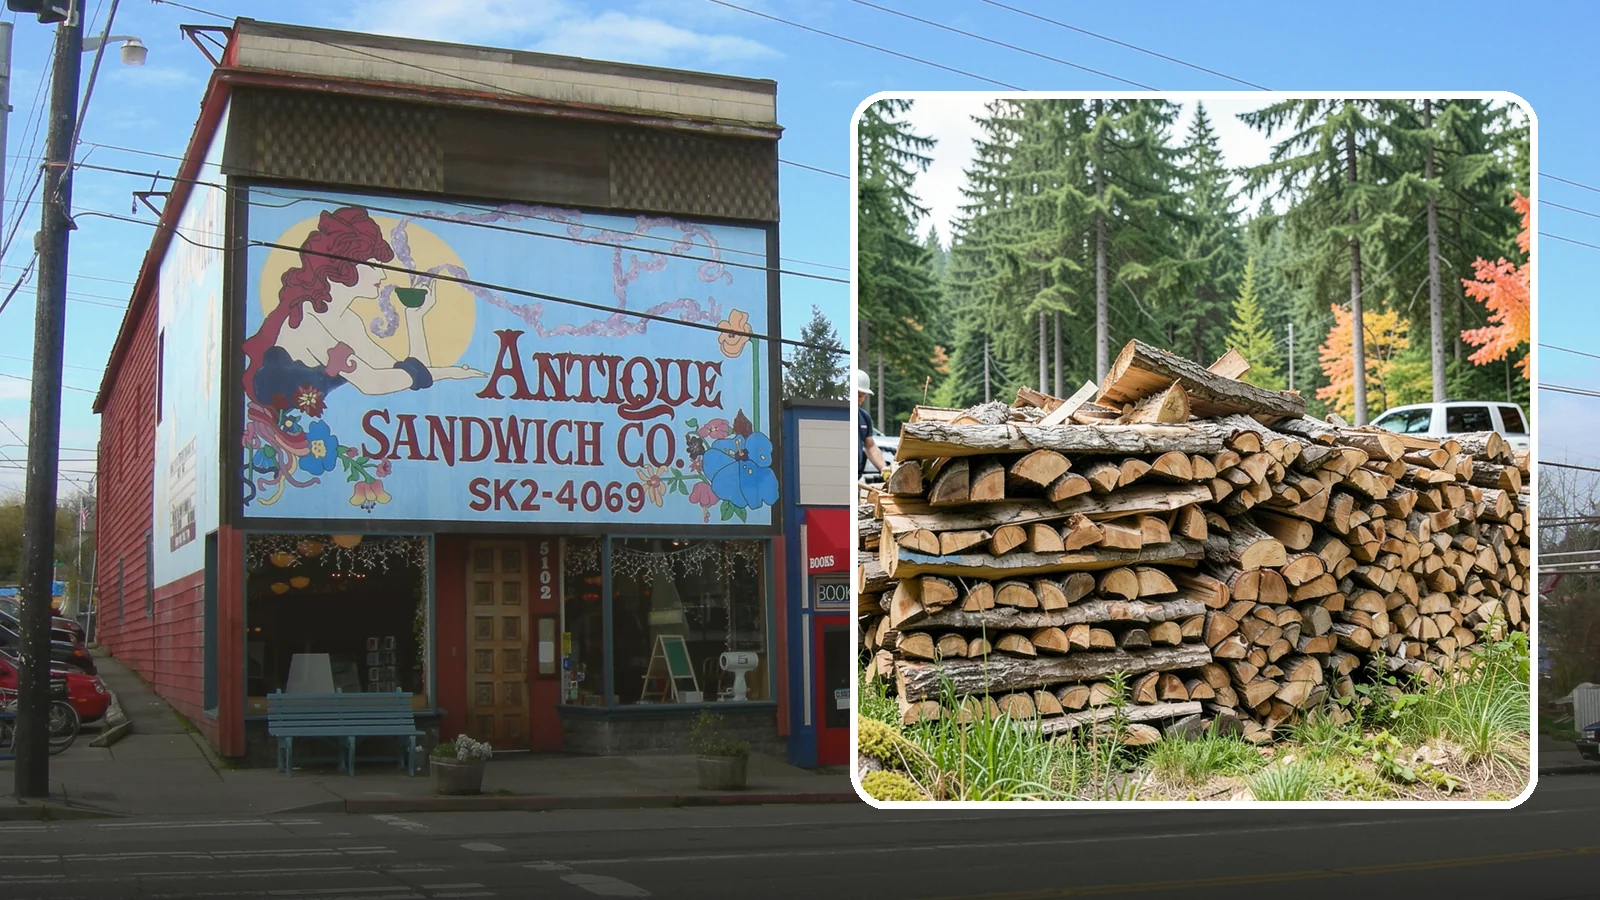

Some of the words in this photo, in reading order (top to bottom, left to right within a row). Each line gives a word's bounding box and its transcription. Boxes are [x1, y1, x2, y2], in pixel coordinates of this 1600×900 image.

[476, 329, 724, 420] ANTIQUE
[361, 408, 605, 467] SANDWICH
[617, 421, 685, 468] CO.
[468, 477, 646, 513] SK2-4069
[540, 541, 551, 600] 5102
[809, 555, 835, 569] BOOKS
